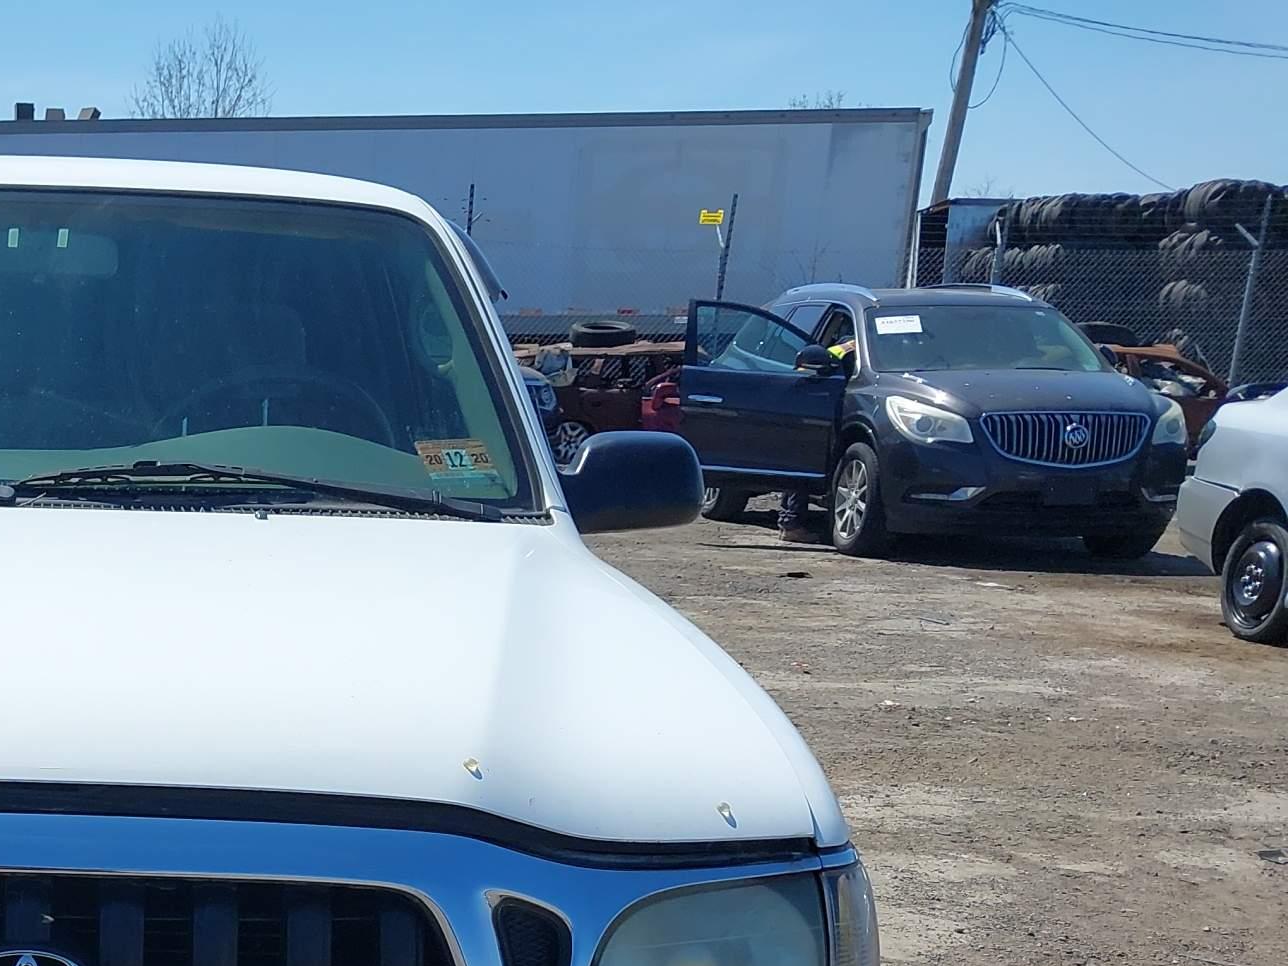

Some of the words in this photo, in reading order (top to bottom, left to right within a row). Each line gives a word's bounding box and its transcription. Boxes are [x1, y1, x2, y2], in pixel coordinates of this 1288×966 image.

[425, 454, 443, 466] 20
[445, 450, 468, 468] 12
[471, 452, 489, 464] 20
